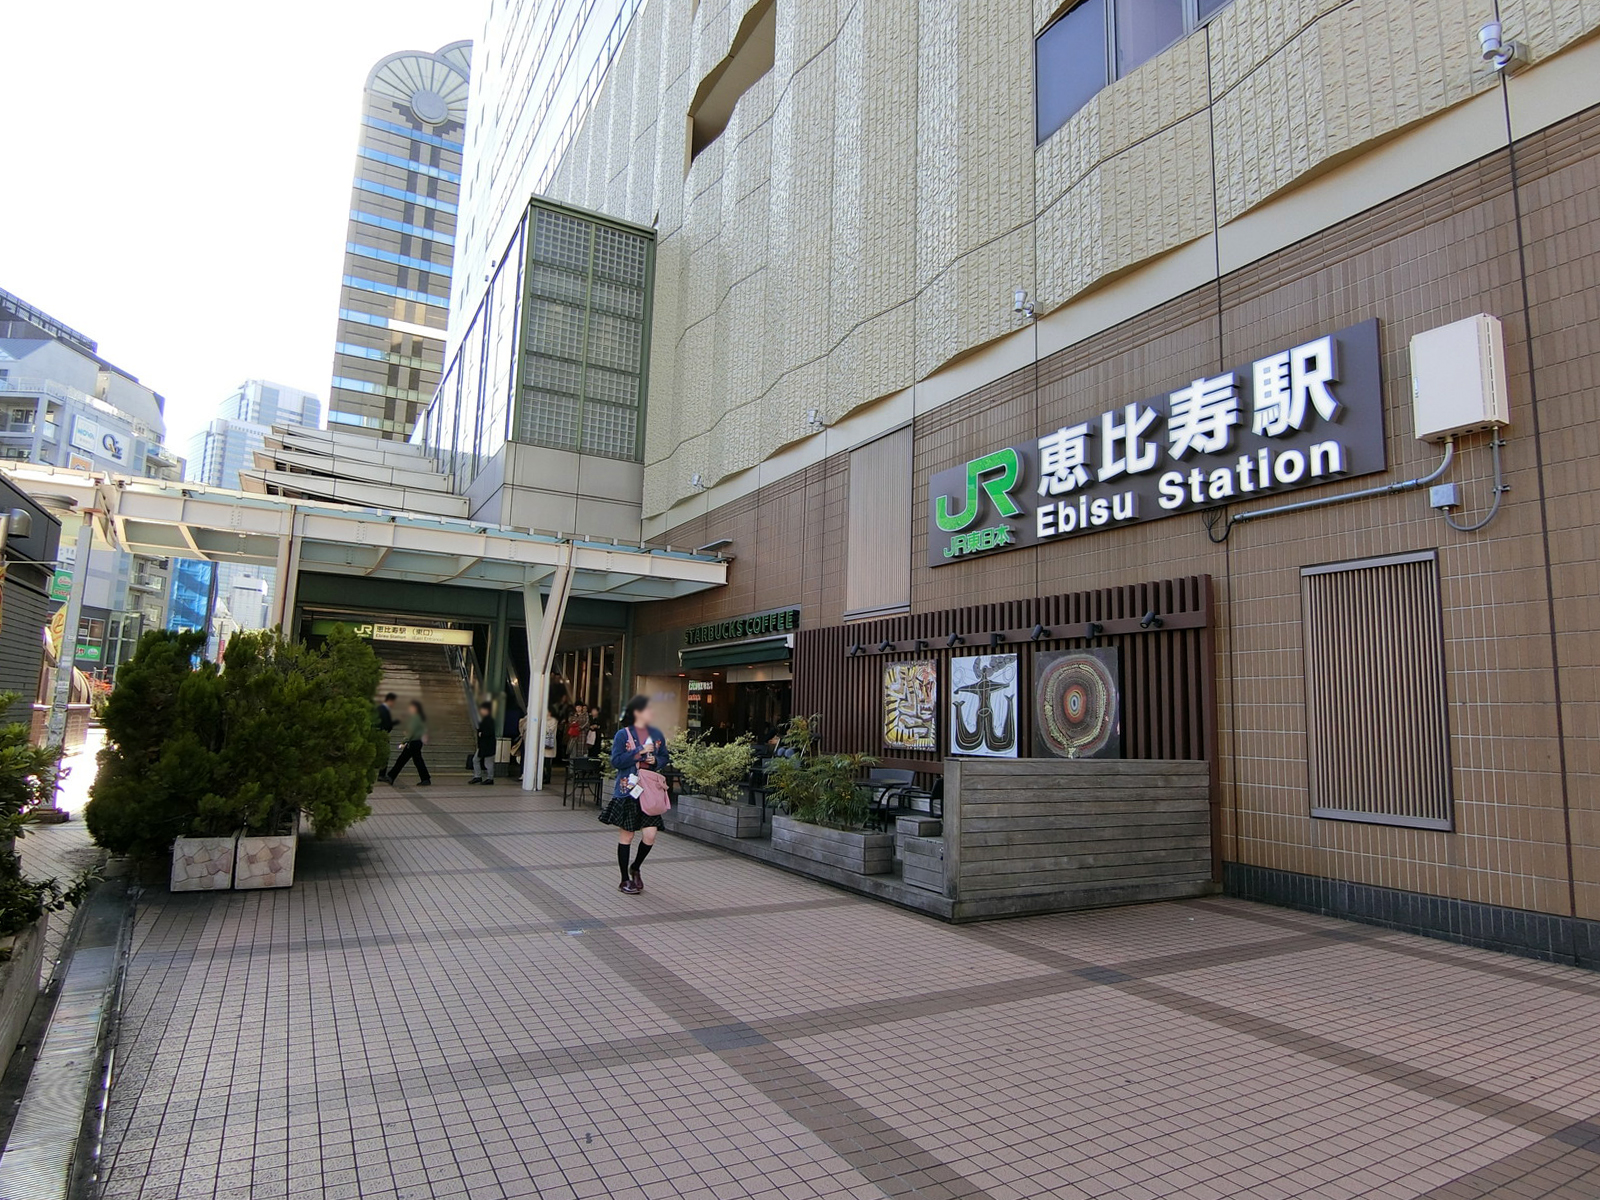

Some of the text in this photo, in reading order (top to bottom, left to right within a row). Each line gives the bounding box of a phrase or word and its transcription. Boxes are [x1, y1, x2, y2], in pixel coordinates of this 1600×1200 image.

[1036, 334, 1341, 497] 恵比寿駅
[935, 447, 1020, 532] JR
[1036, 440, 1343, 538] Ebisu Station
[943, 523, 1012, 558] JR東日本
[354, 624, 373, 635] JR
[376, 625, 407, 635] 恵比寿駅
[684, 610, 796, 644] STARBUCKS COFFEE
